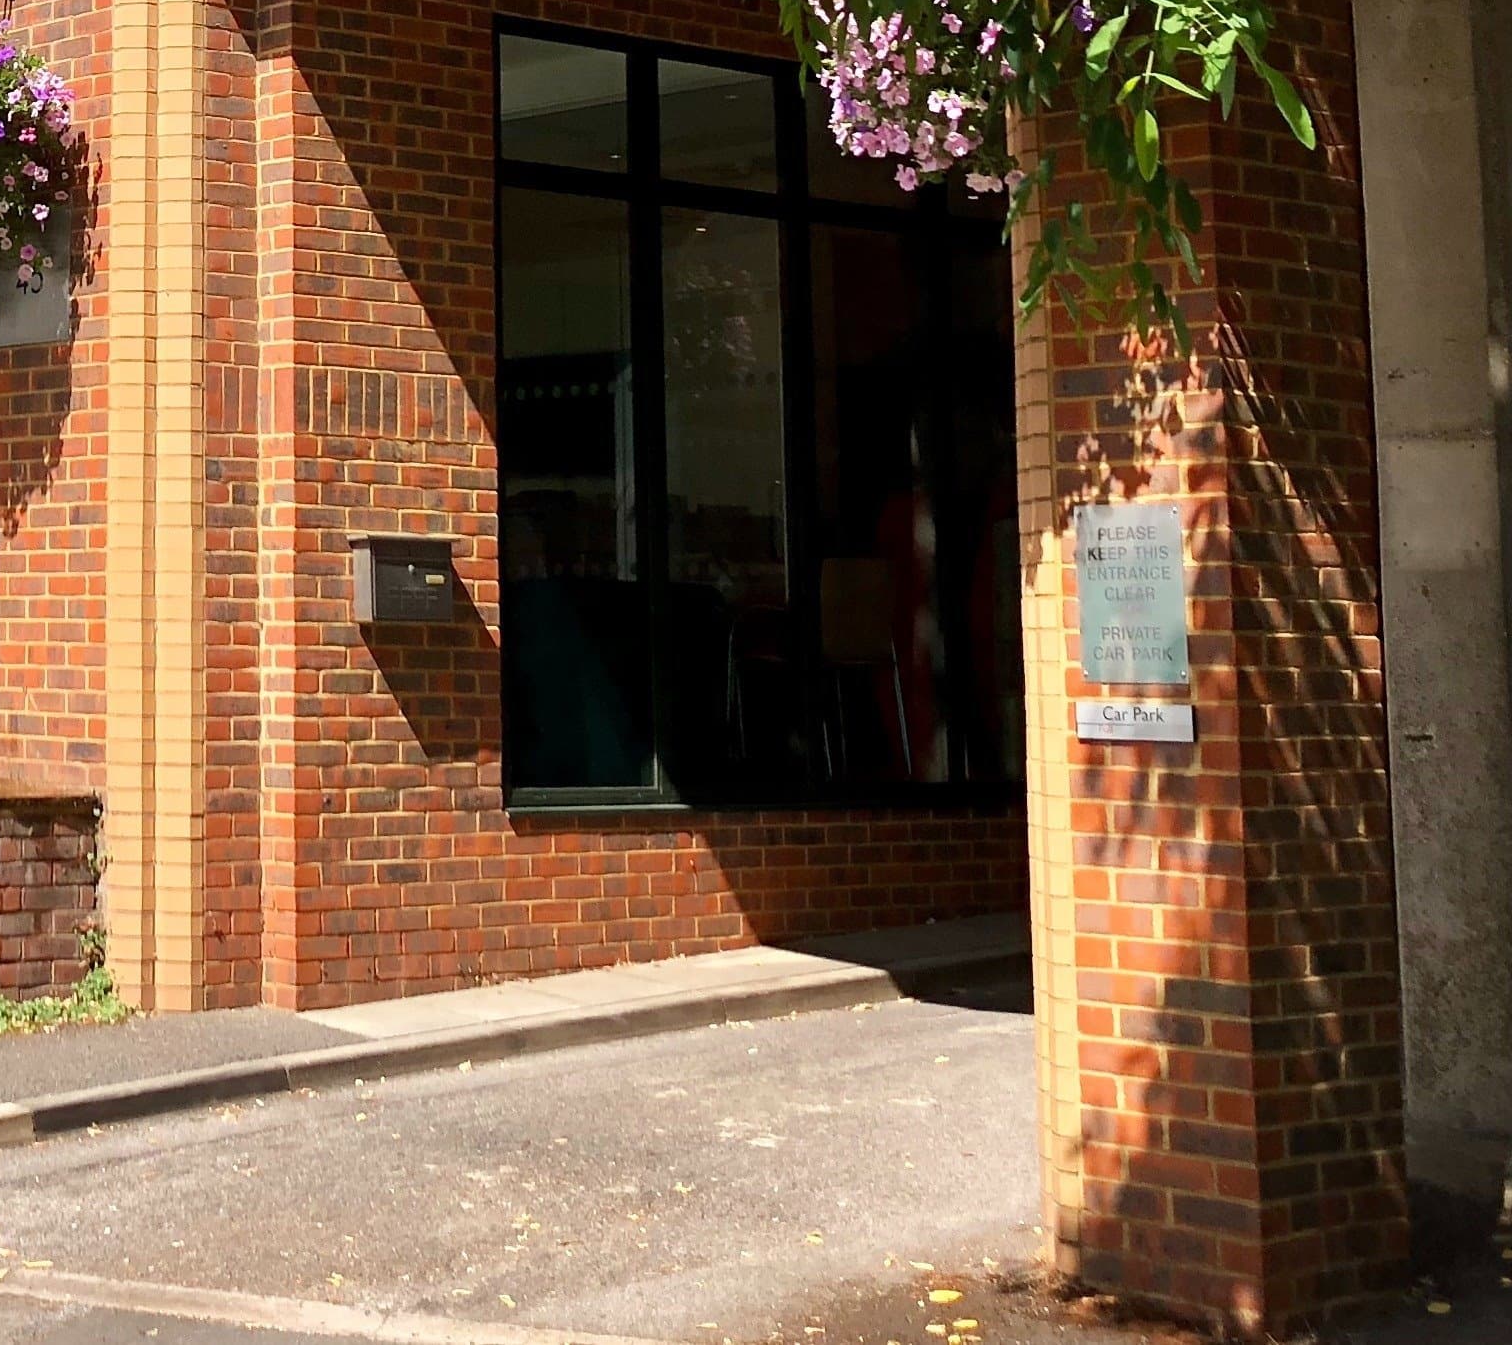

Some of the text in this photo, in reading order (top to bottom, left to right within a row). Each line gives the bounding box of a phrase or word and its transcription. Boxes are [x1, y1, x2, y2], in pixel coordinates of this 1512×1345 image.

[1097, 526, 1157, 541] PLEASE
[1088, 545, 1169, 561] KEEP THIS
[1088, 566, 1172, 581] ENTRANCE
[1104, 586, 1155, 602] CLEAR
[1101, 626, 1161, 640] PRIVATE
[1093, 646, 1173, 661] CAR PARK
[1102, 705, 1165, 723] Car Park
